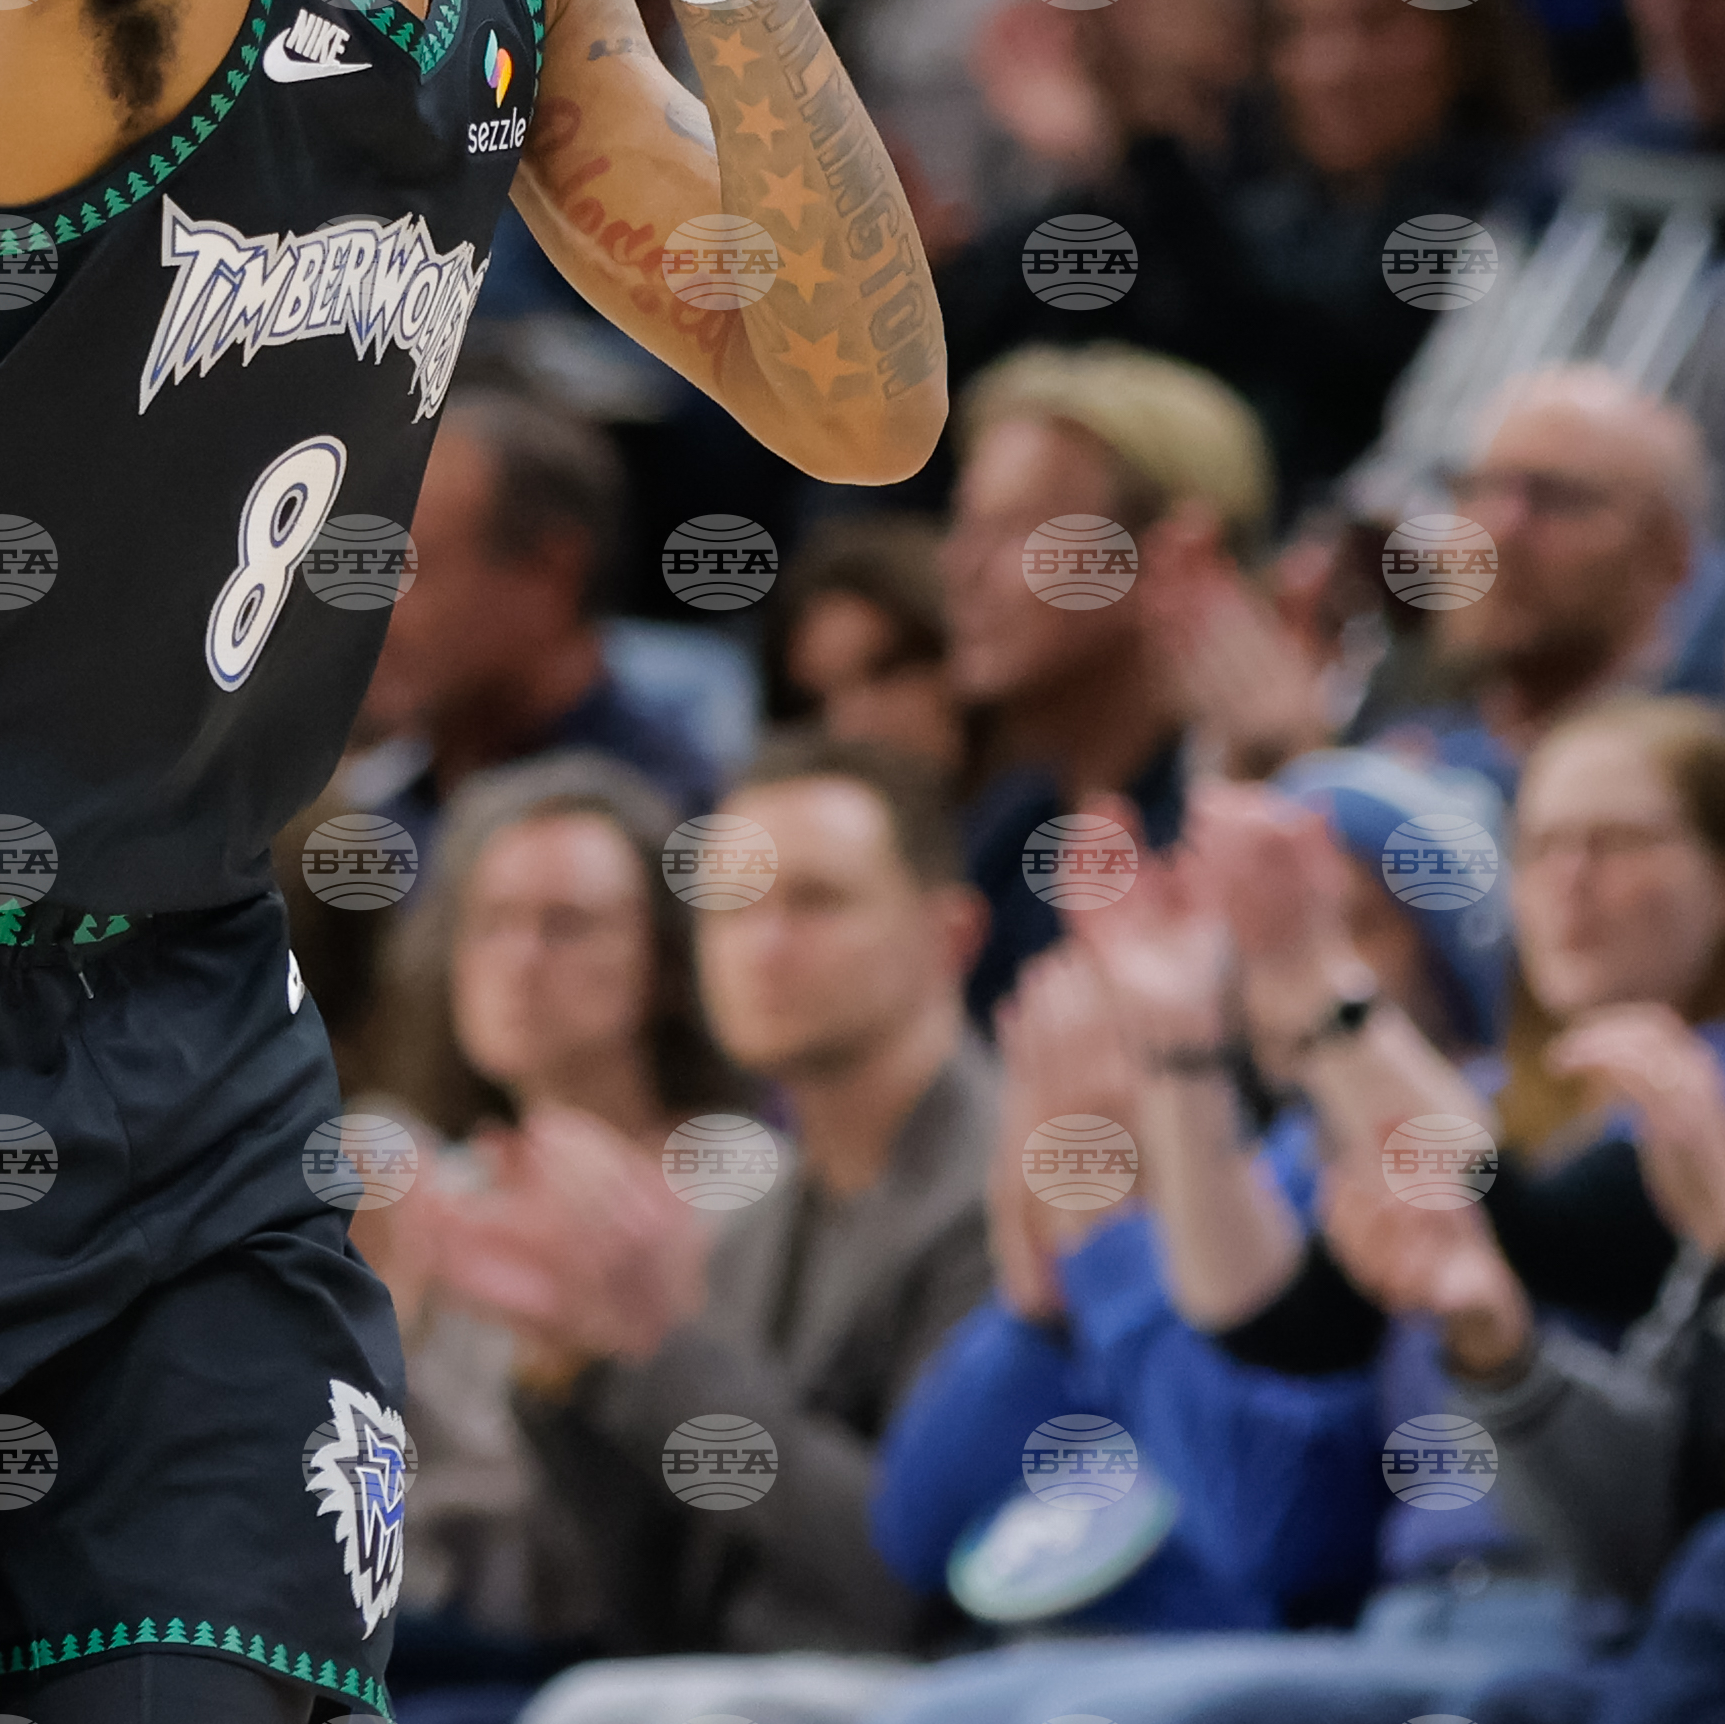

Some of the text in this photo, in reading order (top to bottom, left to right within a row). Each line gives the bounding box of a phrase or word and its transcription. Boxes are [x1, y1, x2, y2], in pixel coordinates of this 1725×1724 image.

[285, 8, 351, 64] NIKE
[468, 107, 527, 154] sezzle
[205, 435, 348, 693] 8
